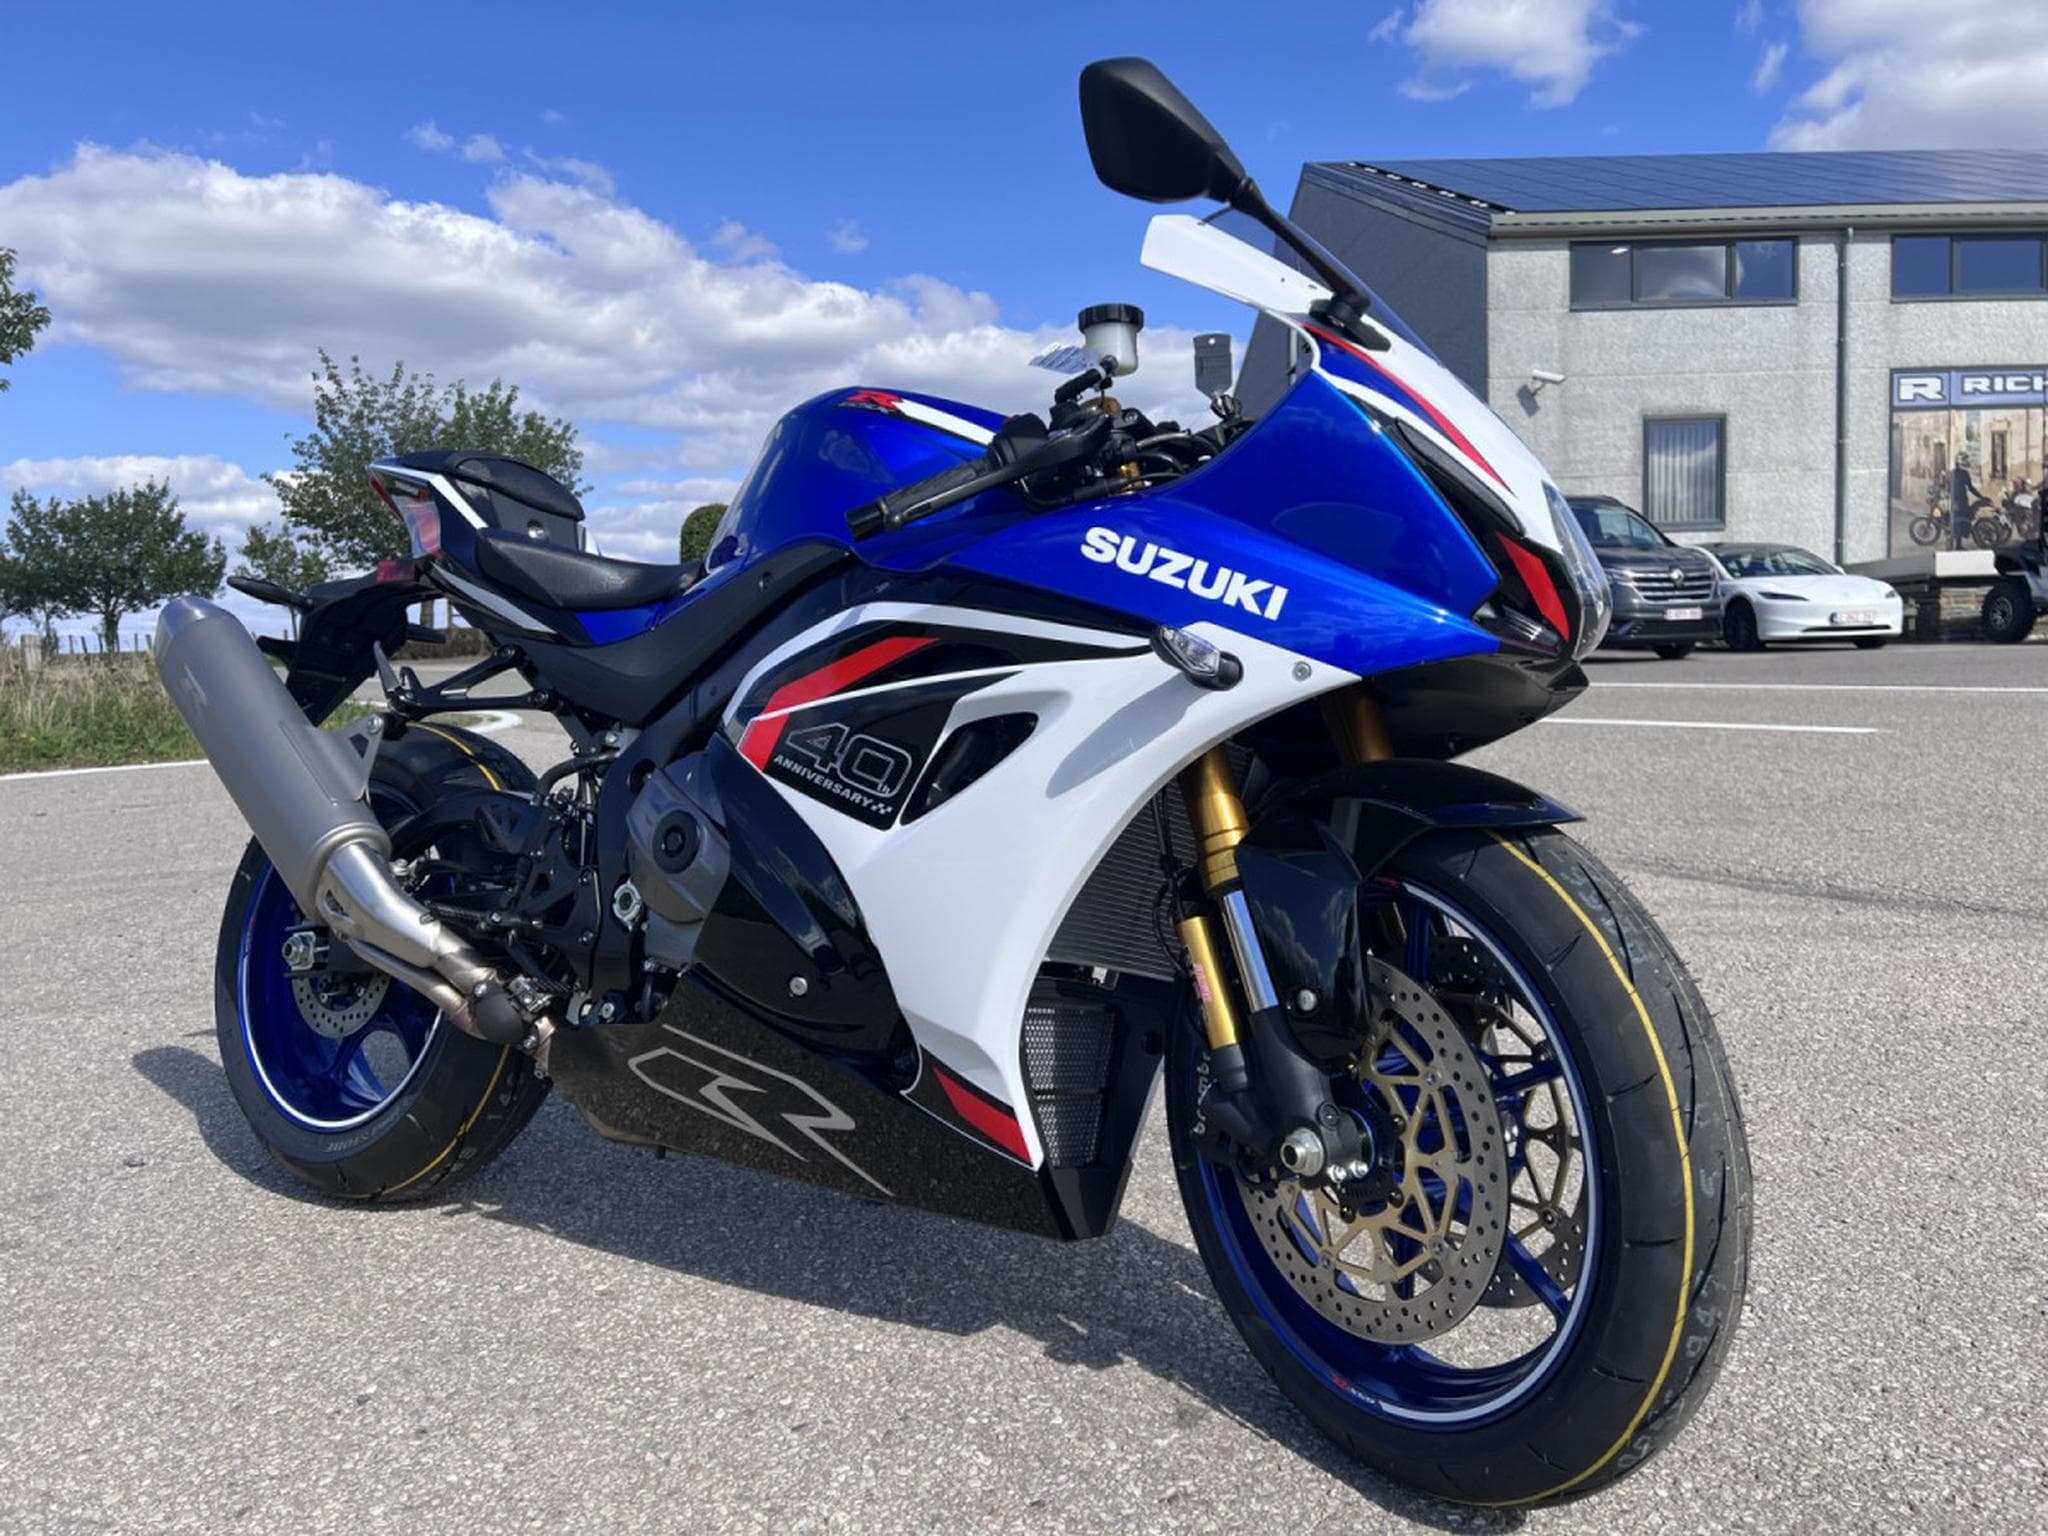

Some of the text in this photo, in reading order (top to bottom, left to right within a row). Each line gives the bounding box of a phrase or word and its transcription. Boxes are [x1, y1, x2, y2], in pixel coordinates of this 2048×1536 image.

[1899, 376, 1946, 401] R
[1080, 526, 1289, 622] SUZUKI
[773, 754, 873, 808] ANNIVERSARY
[1192, 1051, 1212, 1135] brmb
